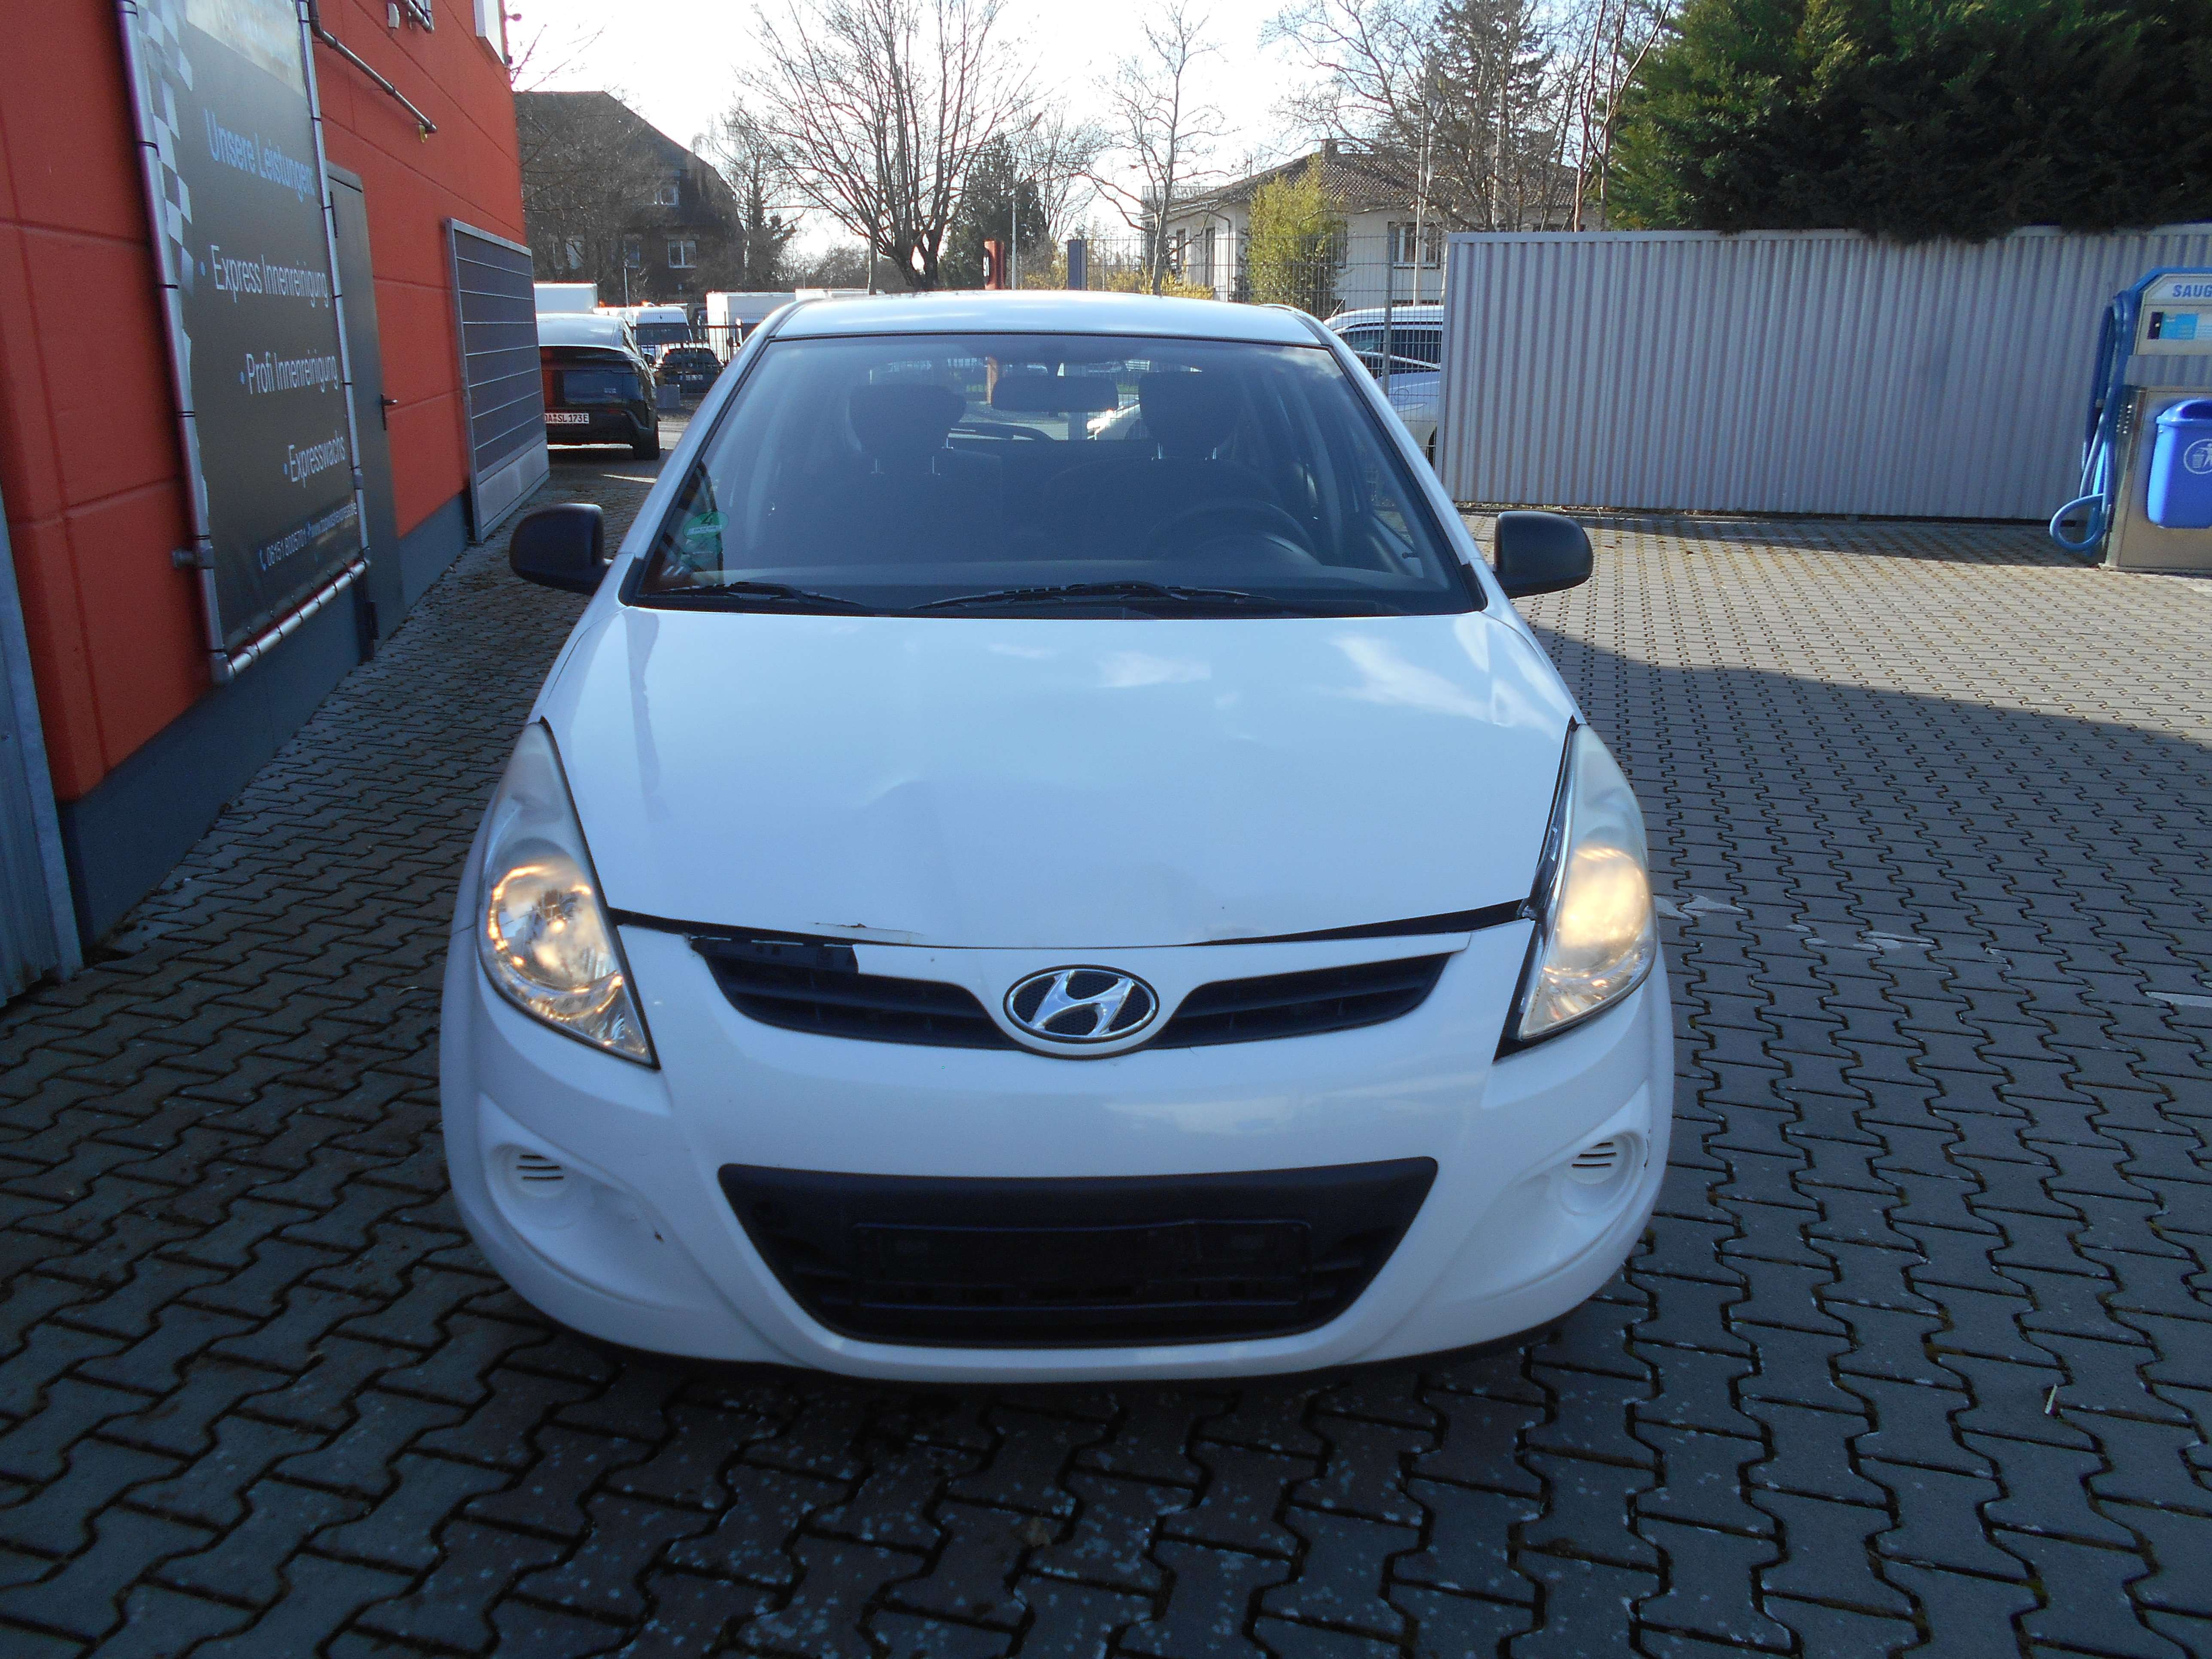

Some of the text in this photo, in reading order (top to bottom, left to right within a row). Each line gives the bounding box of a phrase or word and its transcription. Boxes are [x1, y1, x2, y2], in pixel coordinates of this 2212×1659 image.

[205, 109, 256, 174] Unsere
[211, 244, 329, 308] Express Innenreinigung
[246, 349, 338, 395] Profi Innenreinigung
[288, 429, 345, 488] Expresswachs
